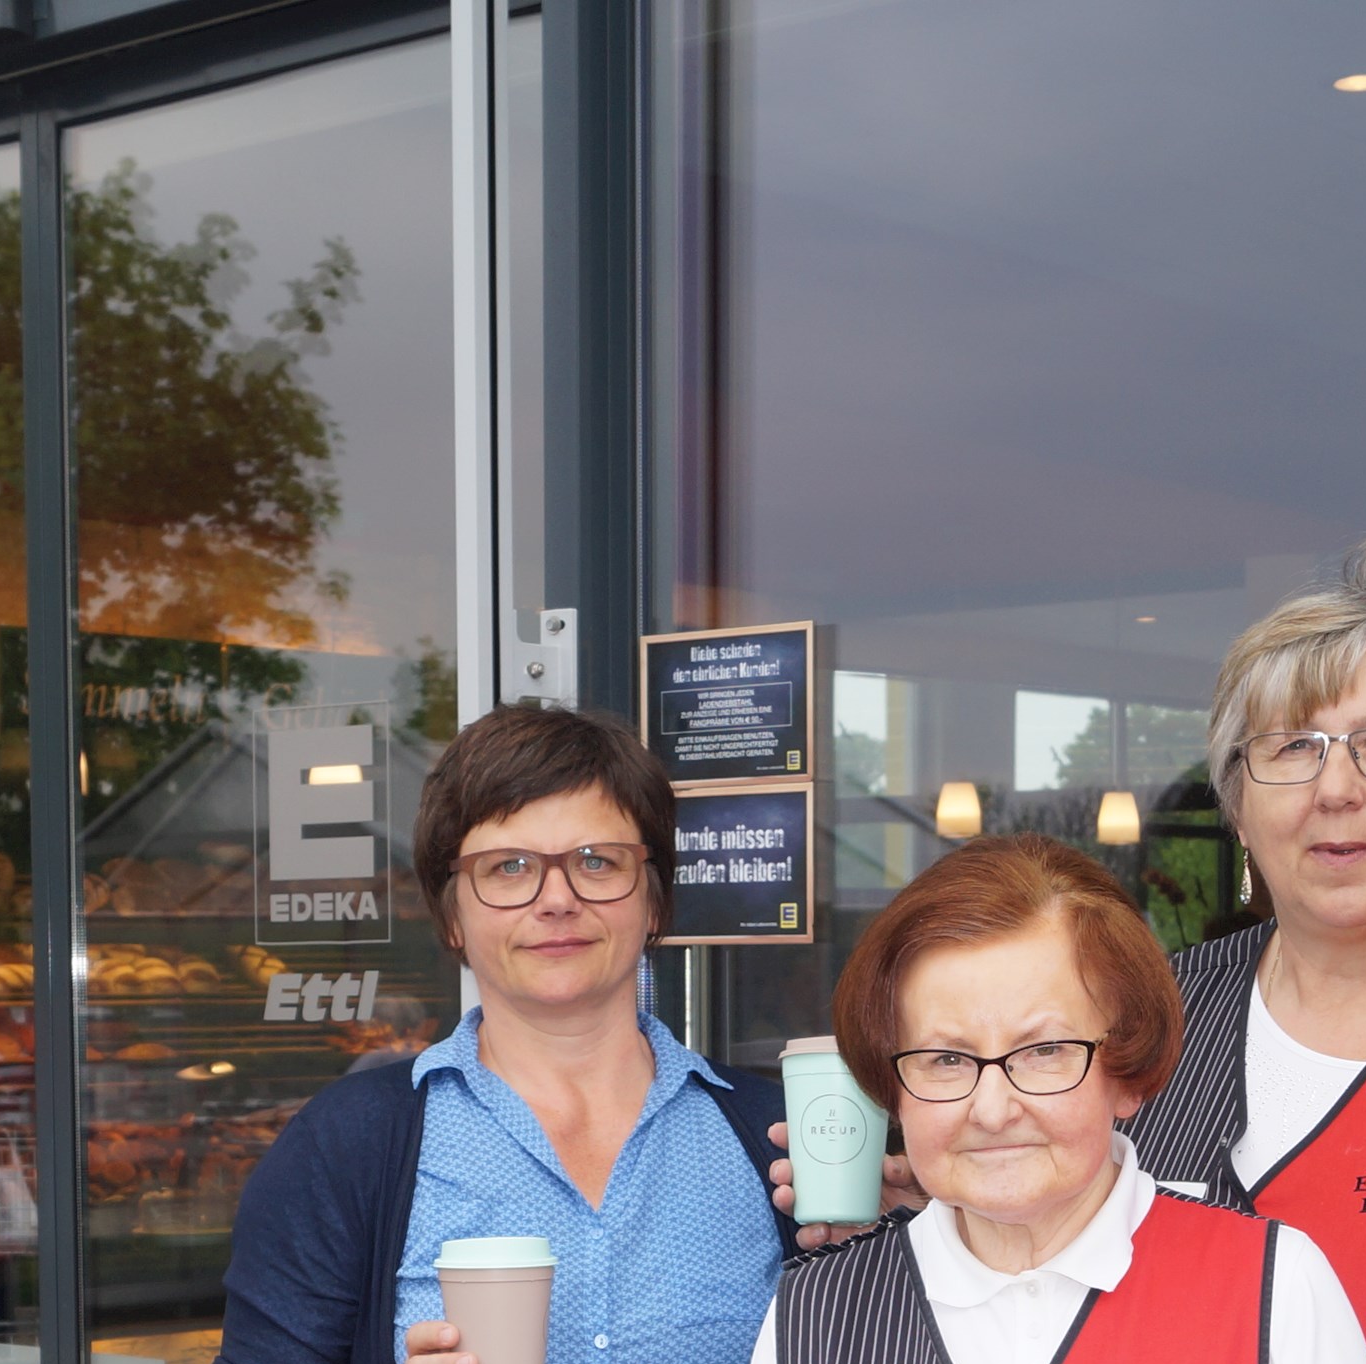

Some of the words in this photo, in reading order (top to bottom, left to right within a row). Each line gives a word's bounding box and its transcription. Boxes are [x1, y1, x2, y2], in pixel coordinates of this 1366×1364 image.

[721, 824, 784, 849] müssen
[673, 858, 726, 884] raußen
[729, 856, 792, 883] bleiben!
[270, 891, 379, 922] EDEKA
[263, 970, 380, 1021] Ettl
[810, 1126, 857, 1135] RECUP
